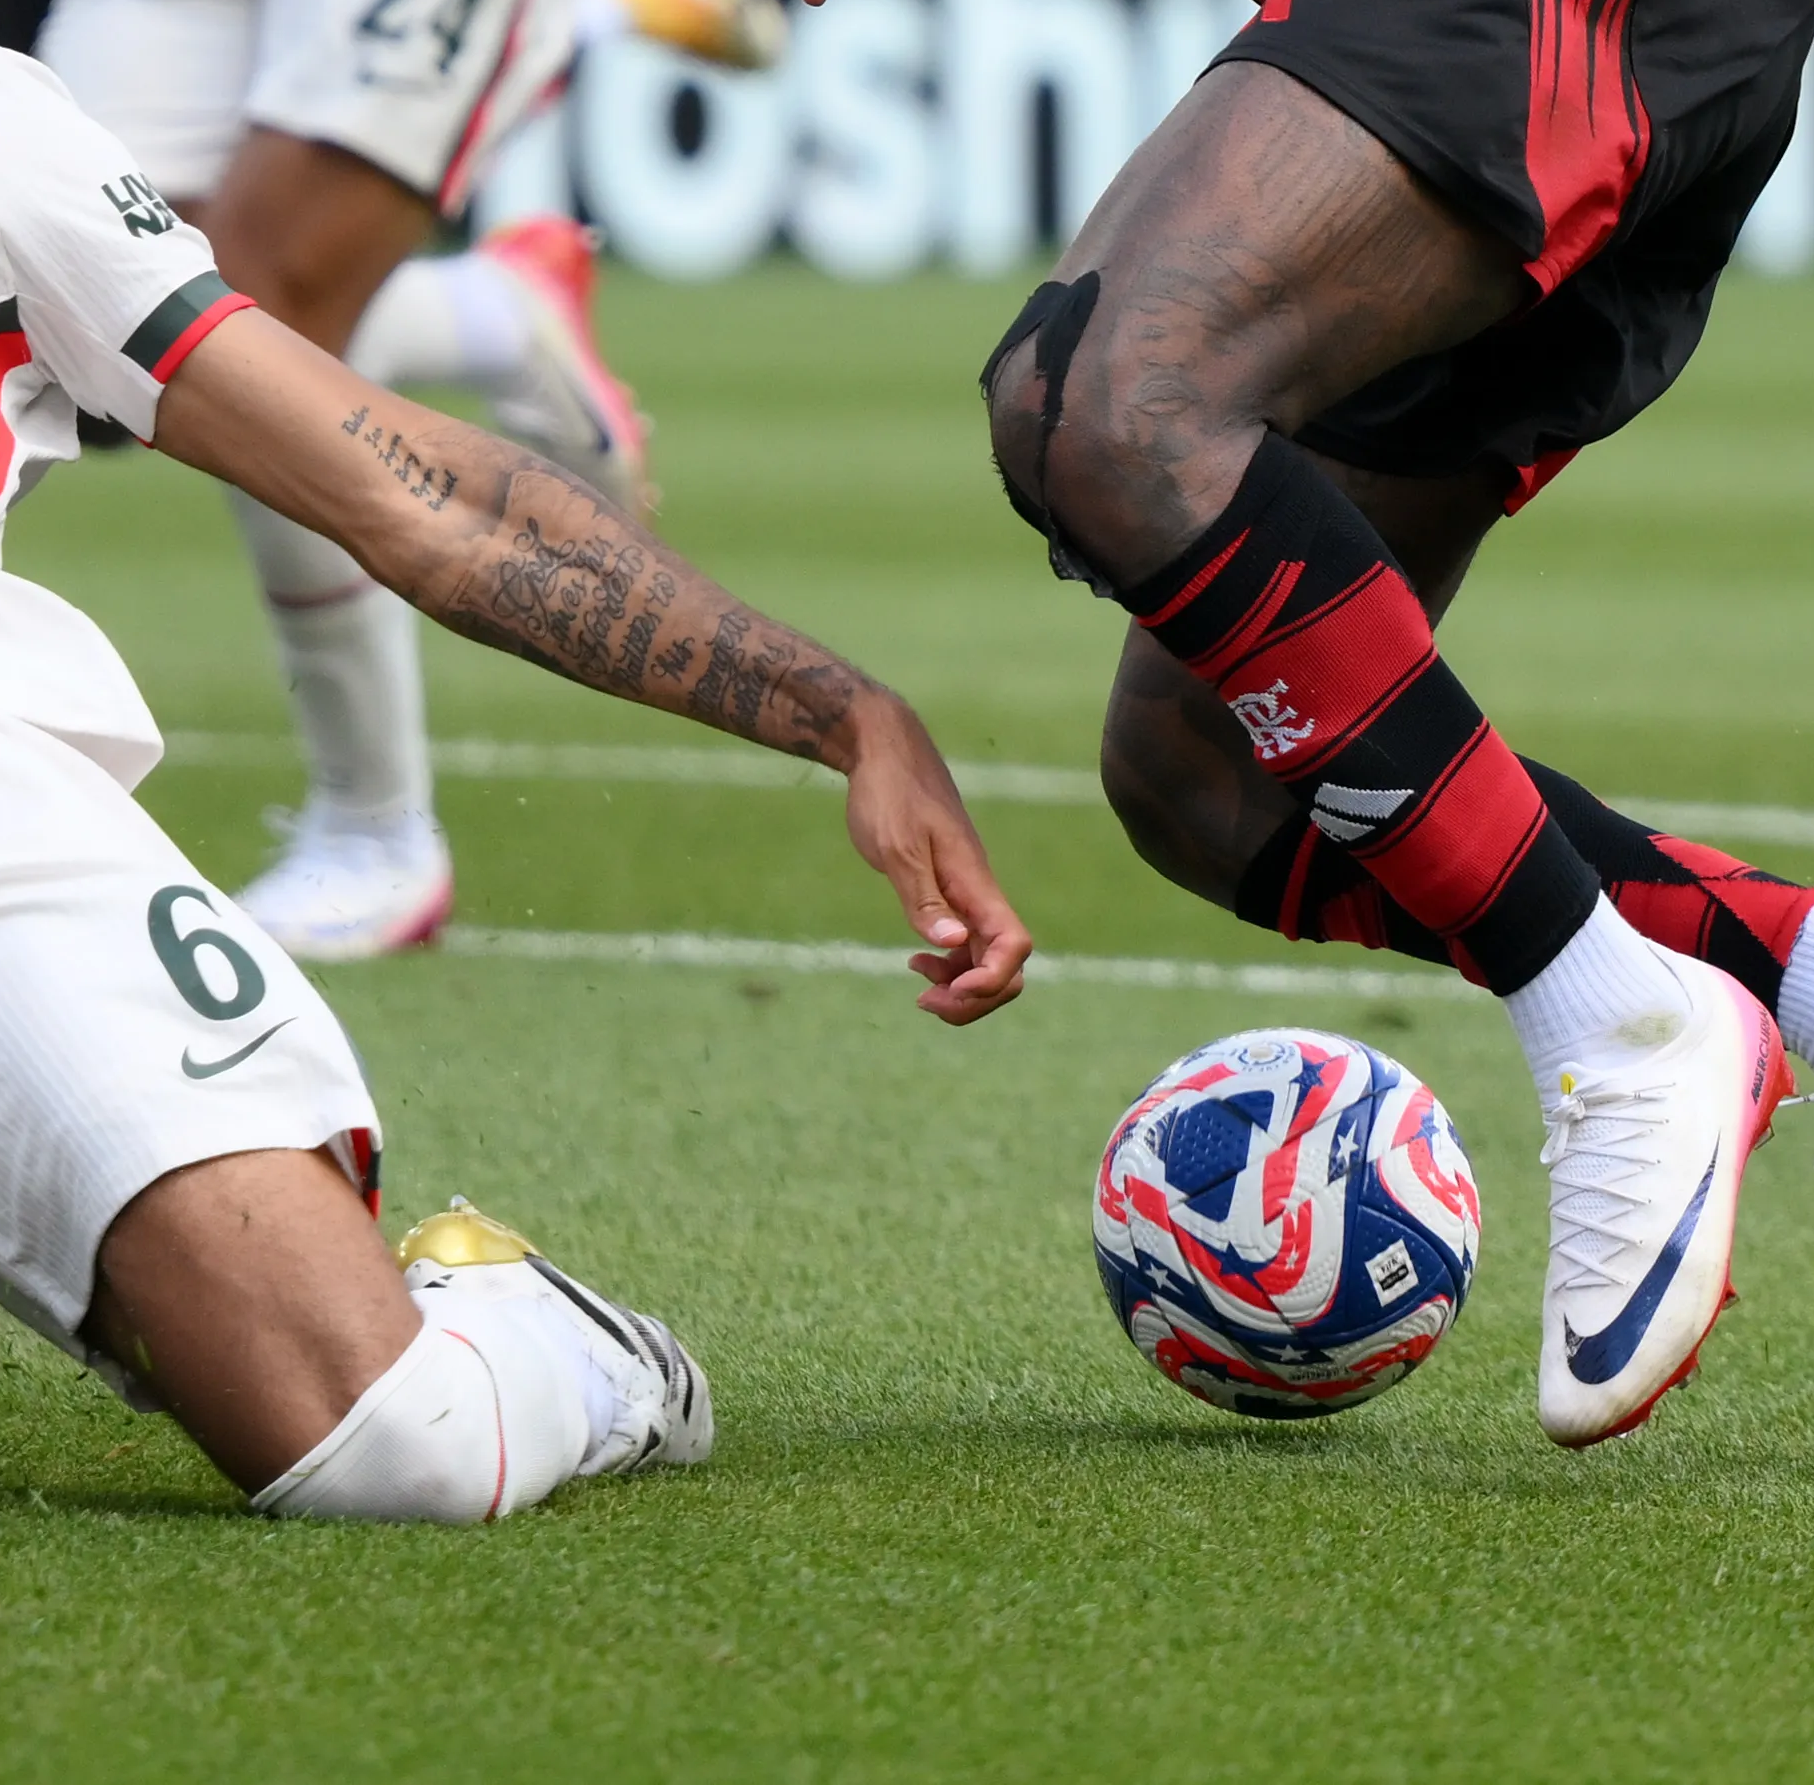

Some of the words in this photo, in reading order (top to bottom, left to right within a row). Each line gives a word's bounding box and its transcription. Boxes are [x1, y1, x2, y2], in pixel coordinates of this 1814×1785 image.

[492, 517, 575, 639] God
[650, 636, 695, 684] his
[147, 884, 267, 1021] 6
